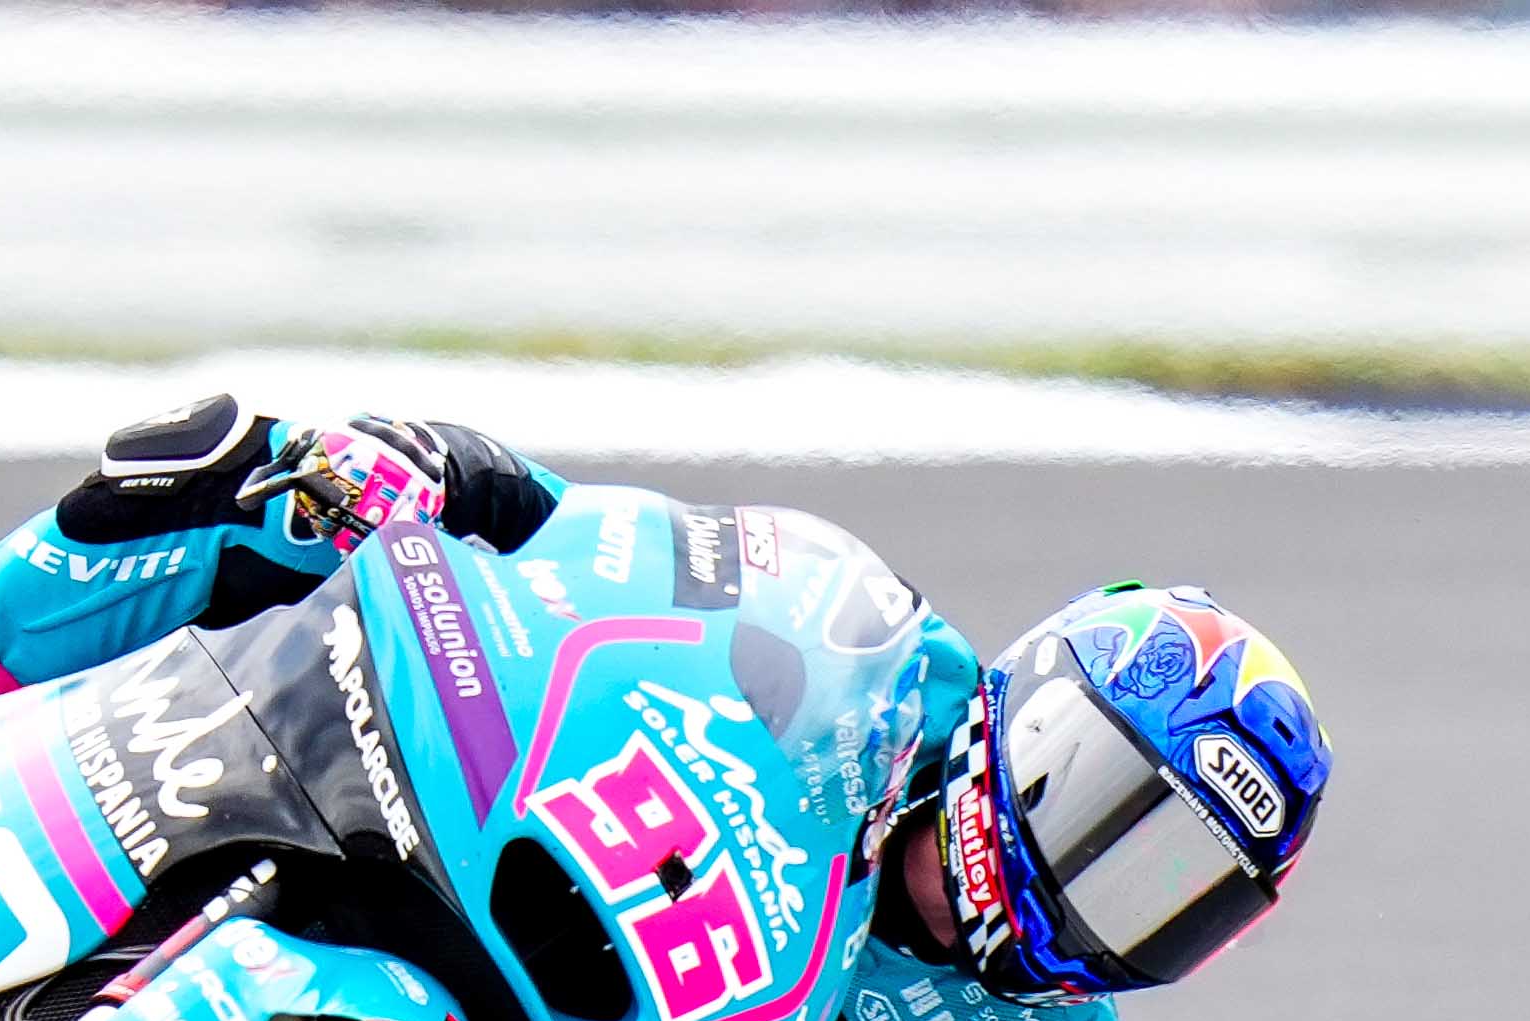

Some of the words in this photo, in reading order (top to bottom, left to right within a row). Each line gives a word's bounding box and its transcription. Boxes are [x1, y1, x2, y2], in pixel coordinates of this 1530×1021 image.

[415, 572, 482, 698] solunion
[82, 729, 171, 877] HISPANIA
[337, 667, 420, 862] POLARCUBE
[622, 690, 716, 784] SOLER
[713, 791, 789, 952] HISPANIA
[1207, 744, 1279, 828] SHOEI
[959, 784, 994, 903] Mutley
